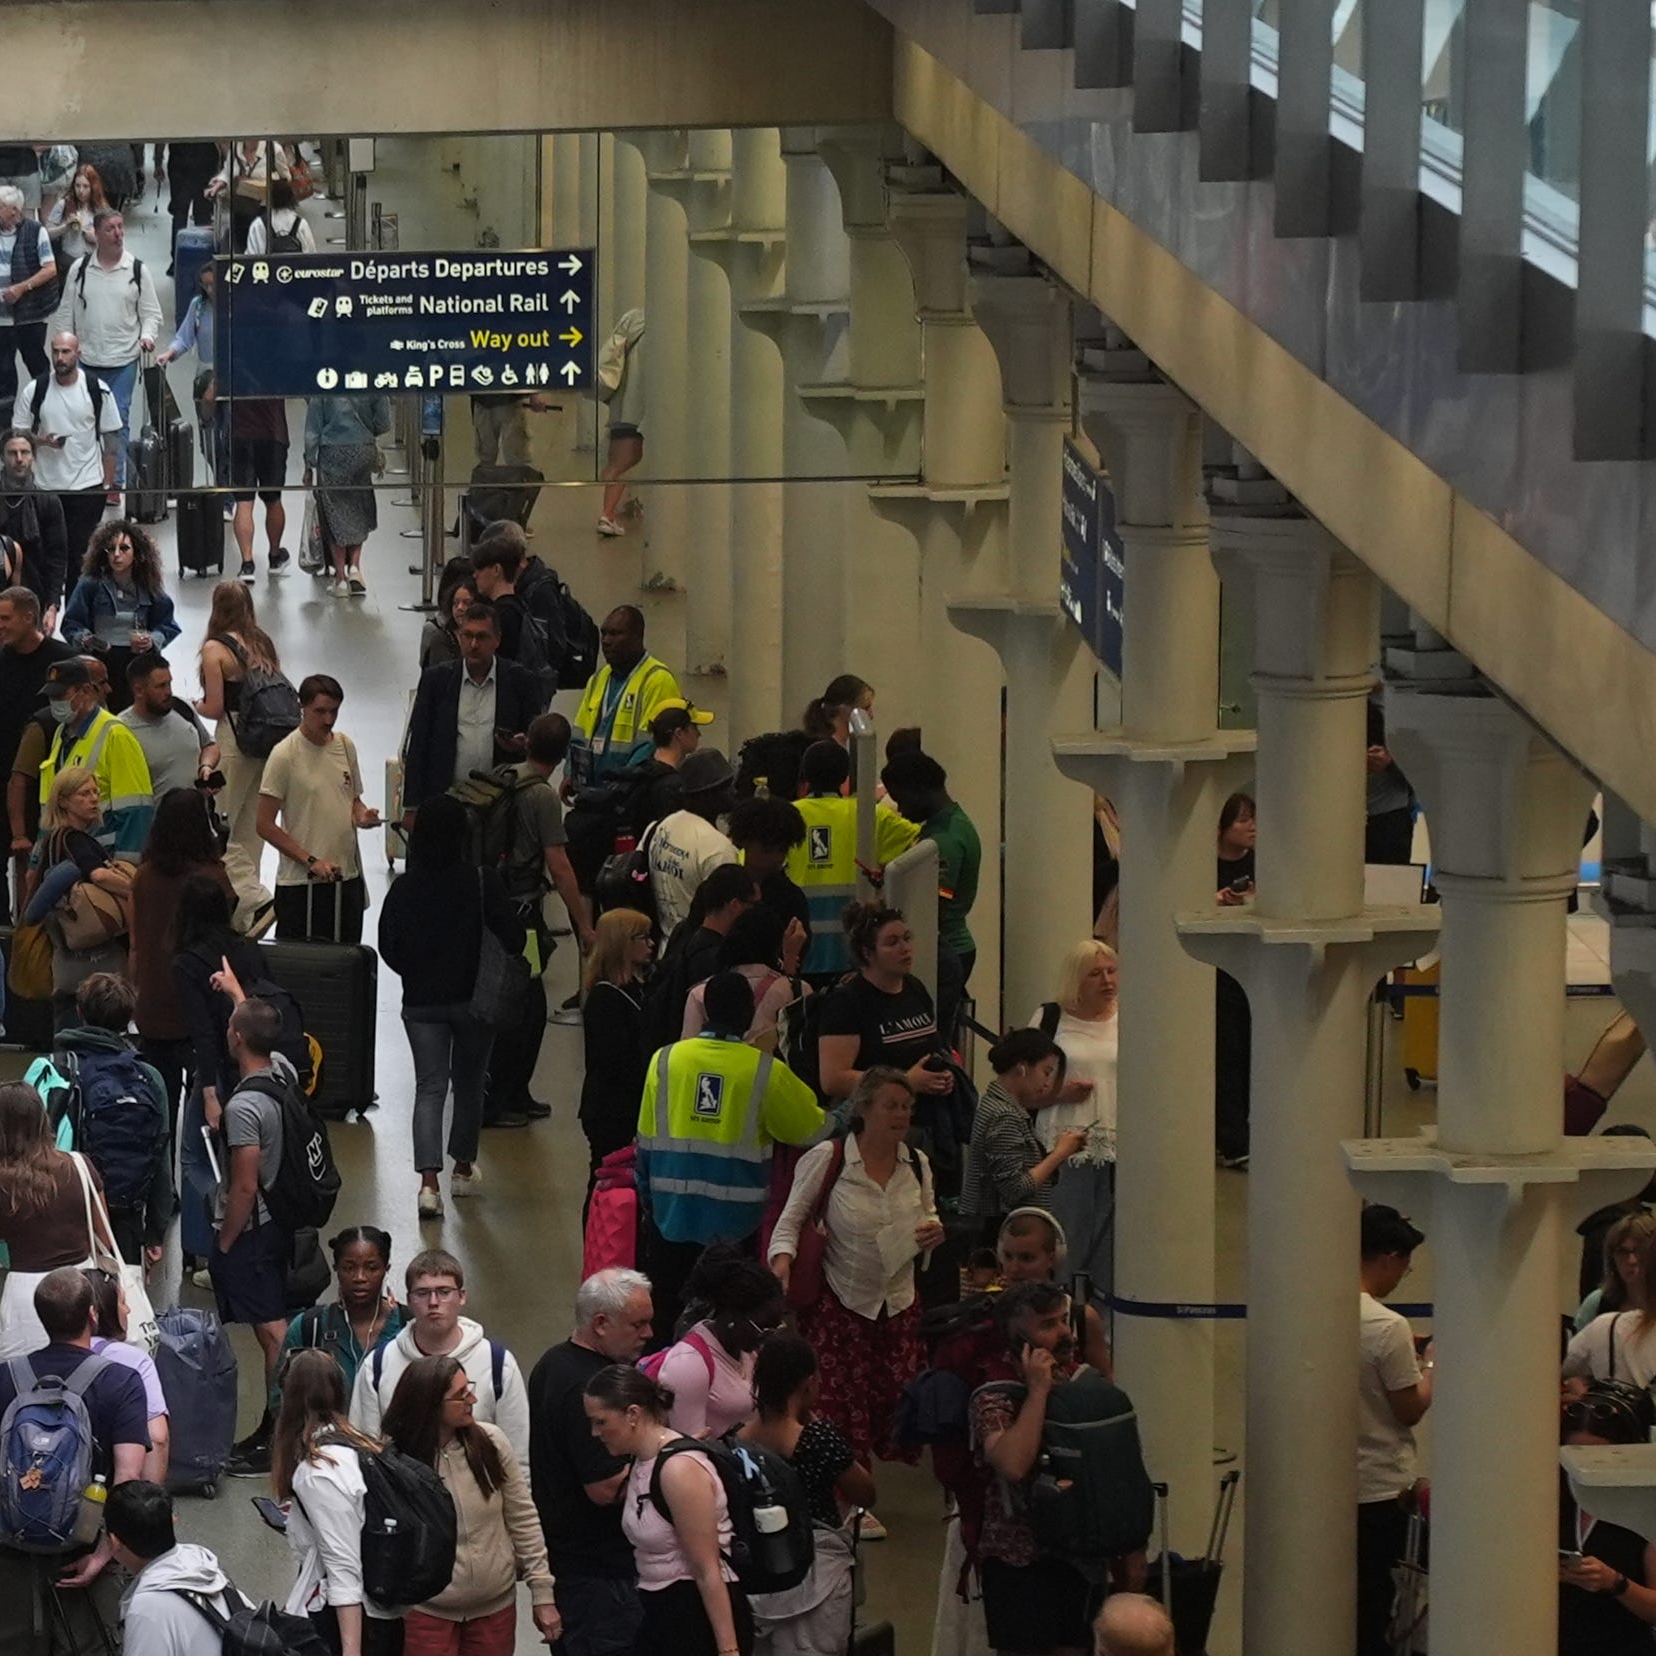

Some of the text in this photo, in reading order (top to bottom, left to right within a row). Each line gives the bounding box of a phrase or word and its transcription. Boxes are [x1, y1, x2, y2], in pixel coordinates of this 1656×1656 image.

[294, 258, 550, 284] eurostar Départs Departures
[359, 294, 413, 305] Tickets and
[419, 294, 549, 315] National Rail
[366, 305, 414, 317] platforms
[406, 338, 465, 352] King's Cross
[469, 330, 550, 353] Way out
